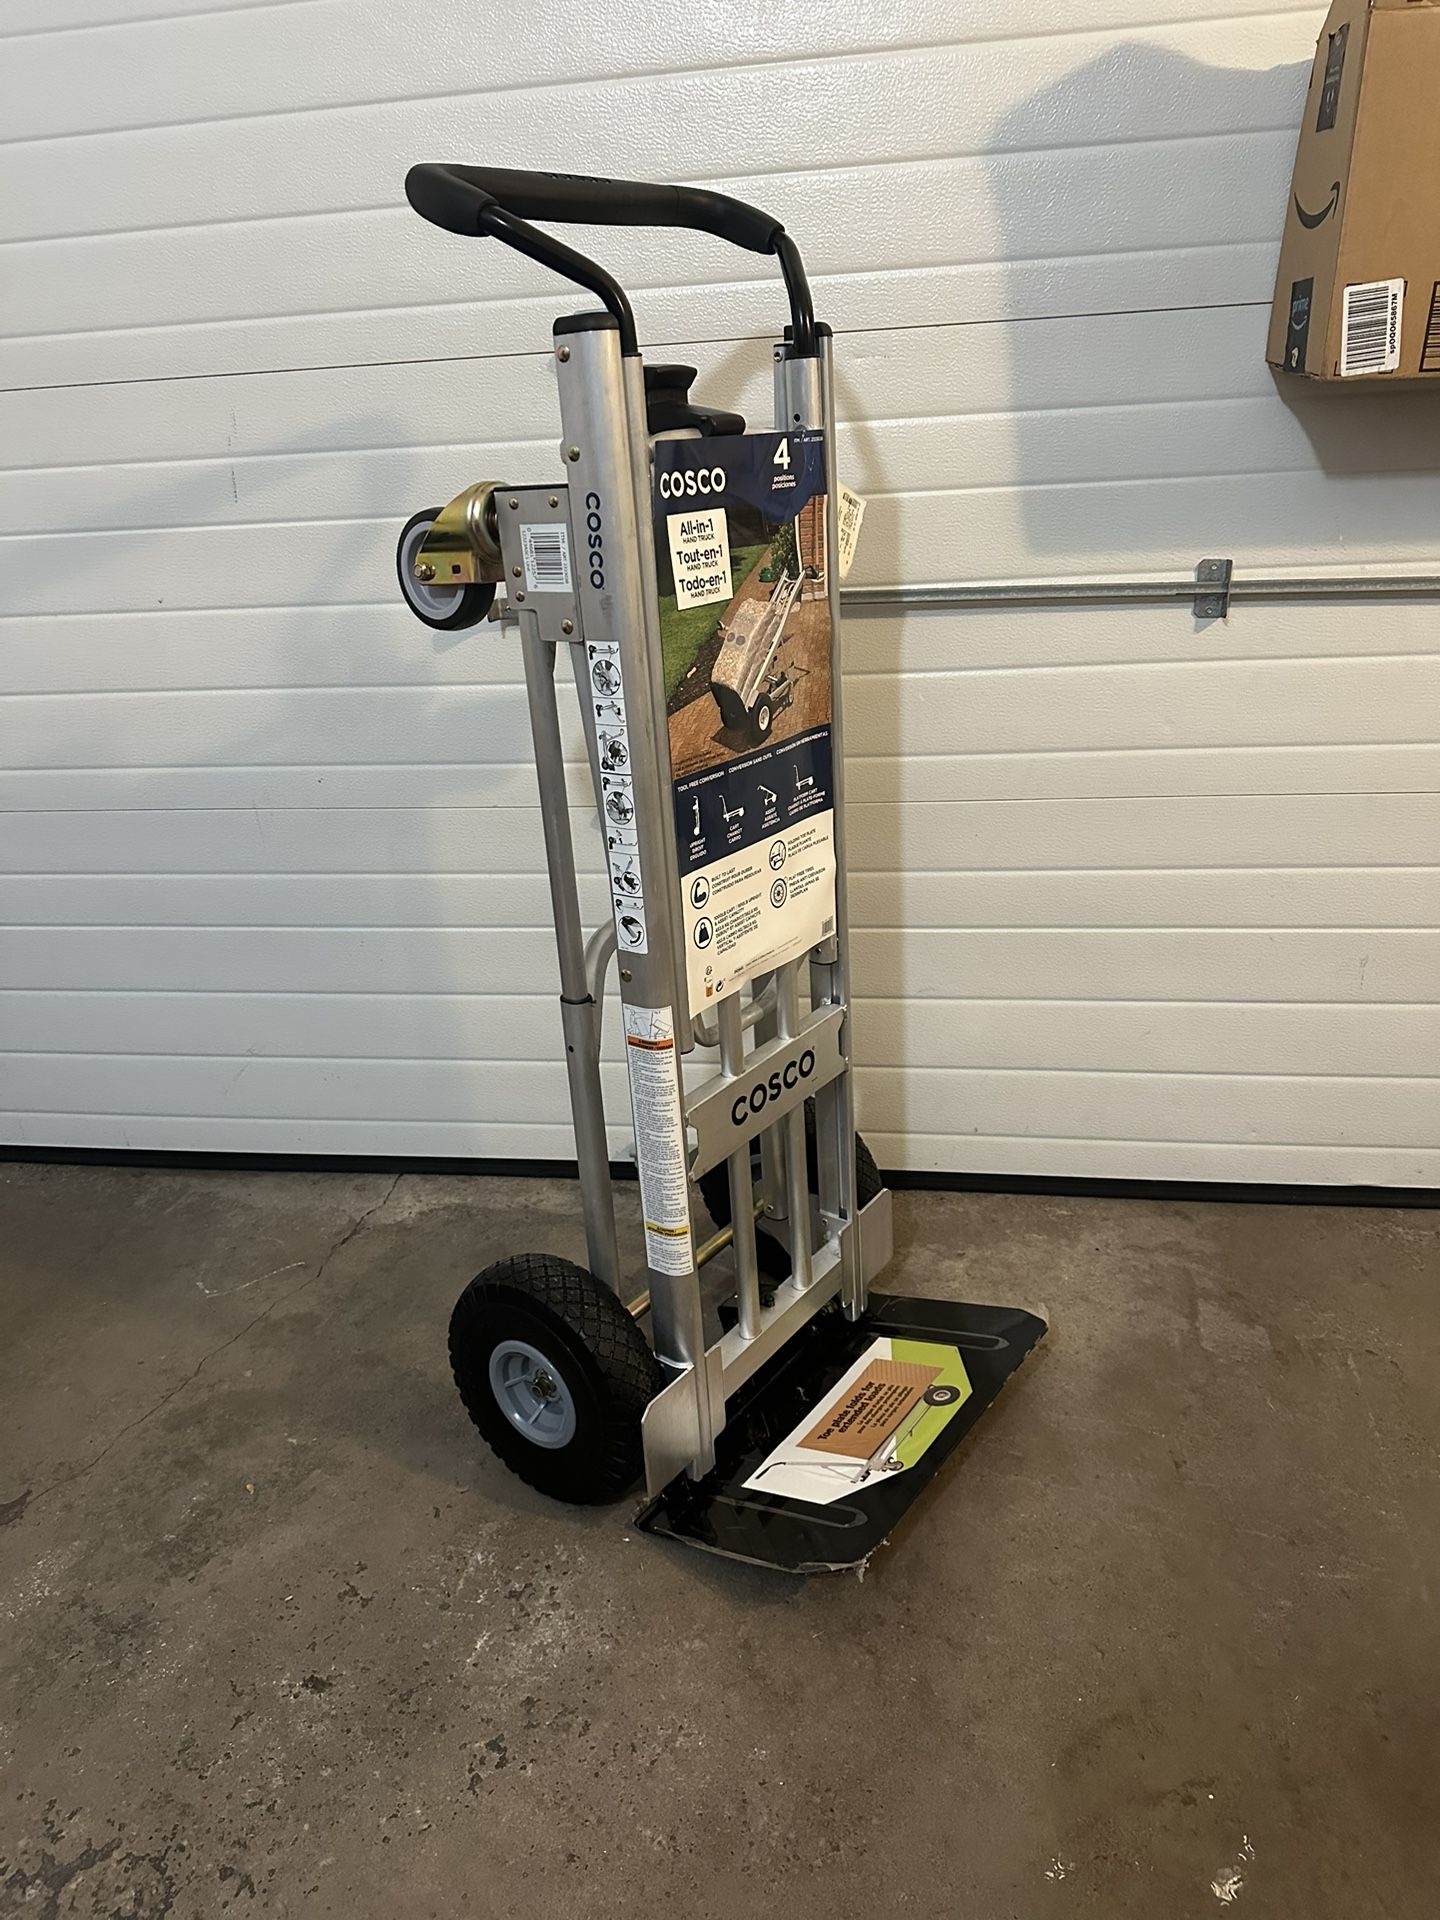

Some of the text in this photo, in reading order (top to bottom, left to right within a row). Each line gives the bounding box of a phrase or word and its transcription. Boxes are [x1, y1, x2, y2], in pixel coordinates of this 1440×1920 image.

[774, 438, 791, 470] 4
[660, 467, 726, 499] COSCO
[772, 481, 797, 490] posiciones
[774, 475, 795, 483] positions
[680, 517, 714, 536] All-in-1
[586, 492, 604, 589] COSCO
[683, 533, 715, 544] HAND TRUCK
[676, 544, 723, 565] Tout-en-1
[687, 560, 719, 571] HAND TRUCK
[679, 570, 727, 593] Todo-en-1
[690, 587, 721, 598] HAND TRUCK
[728, 761, 752, 773] CONVERSION
[677, 784, 688, 792] TOOL
[698, 771, 724, 784] CONVERSION
[732, 1050, 815, 1126] COSCO
[817, 1381, 875, 1440] Toe plate folds for
[838, 1383, 886, 1433] extended loads
